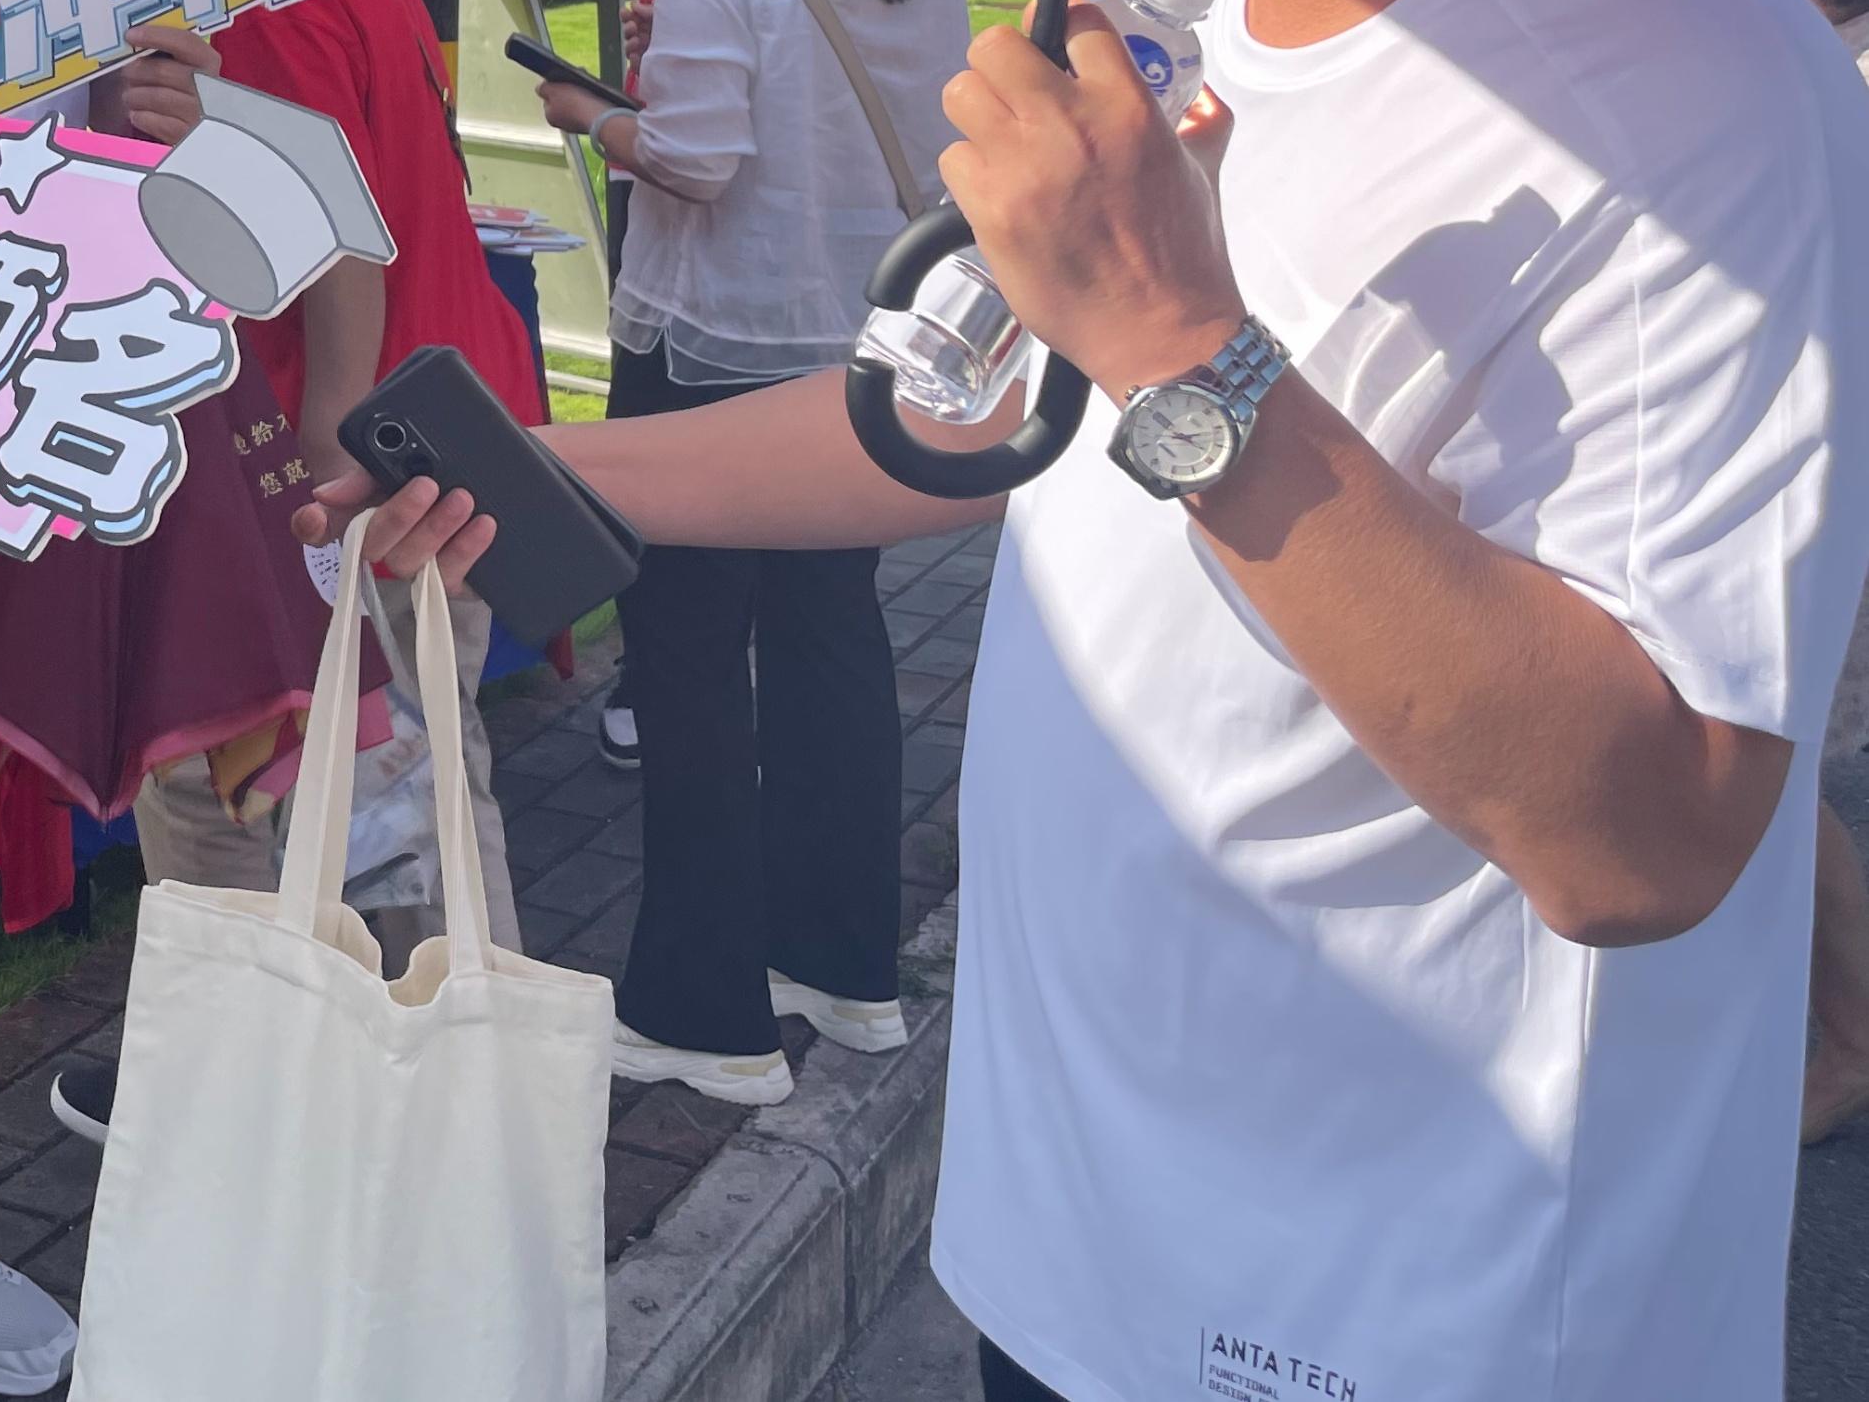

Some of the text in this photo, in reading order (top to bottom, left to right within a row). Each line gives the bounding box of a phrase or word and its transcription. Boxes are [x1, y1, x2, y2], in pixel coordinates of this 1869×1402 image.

[1208, 1363, 1280, 1401] FUNCTIONAL
[1211, 1332, 1357, 1402] ANTA TECH
